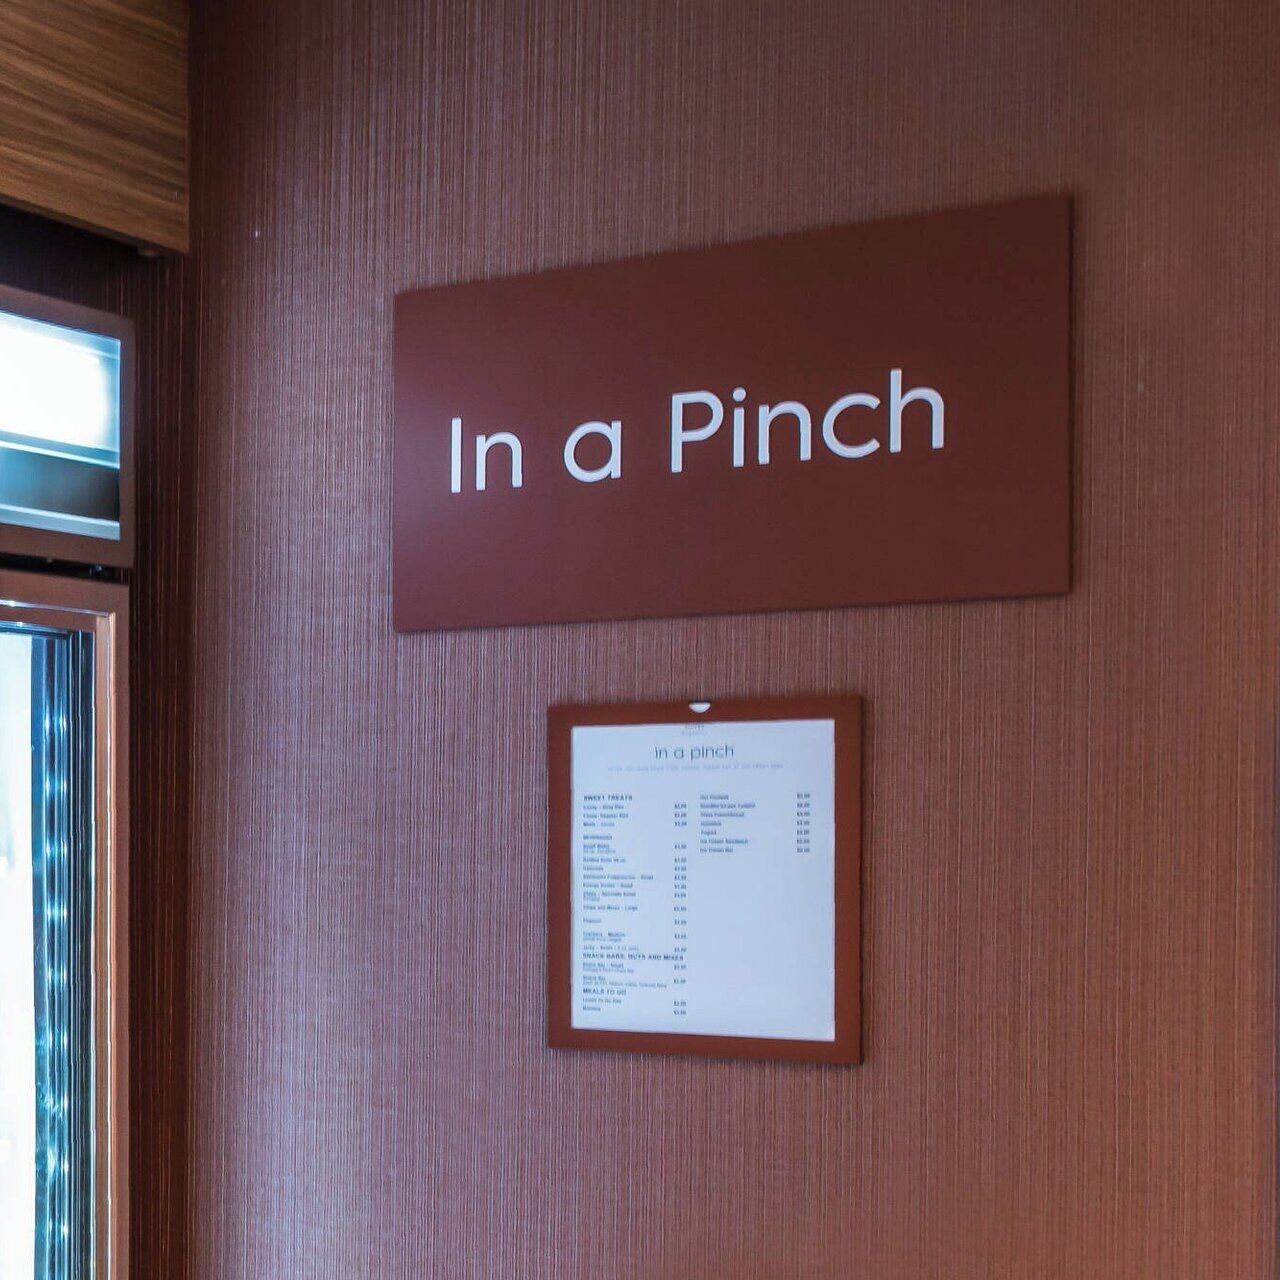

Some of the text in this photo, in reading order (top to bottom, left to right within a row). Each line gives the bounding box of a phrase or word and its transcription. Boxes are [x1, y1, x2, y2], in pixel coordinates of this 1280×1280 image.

[449, 367, 946, 494] In a Pinch
[654, 743, 735, 761] in a pinch
